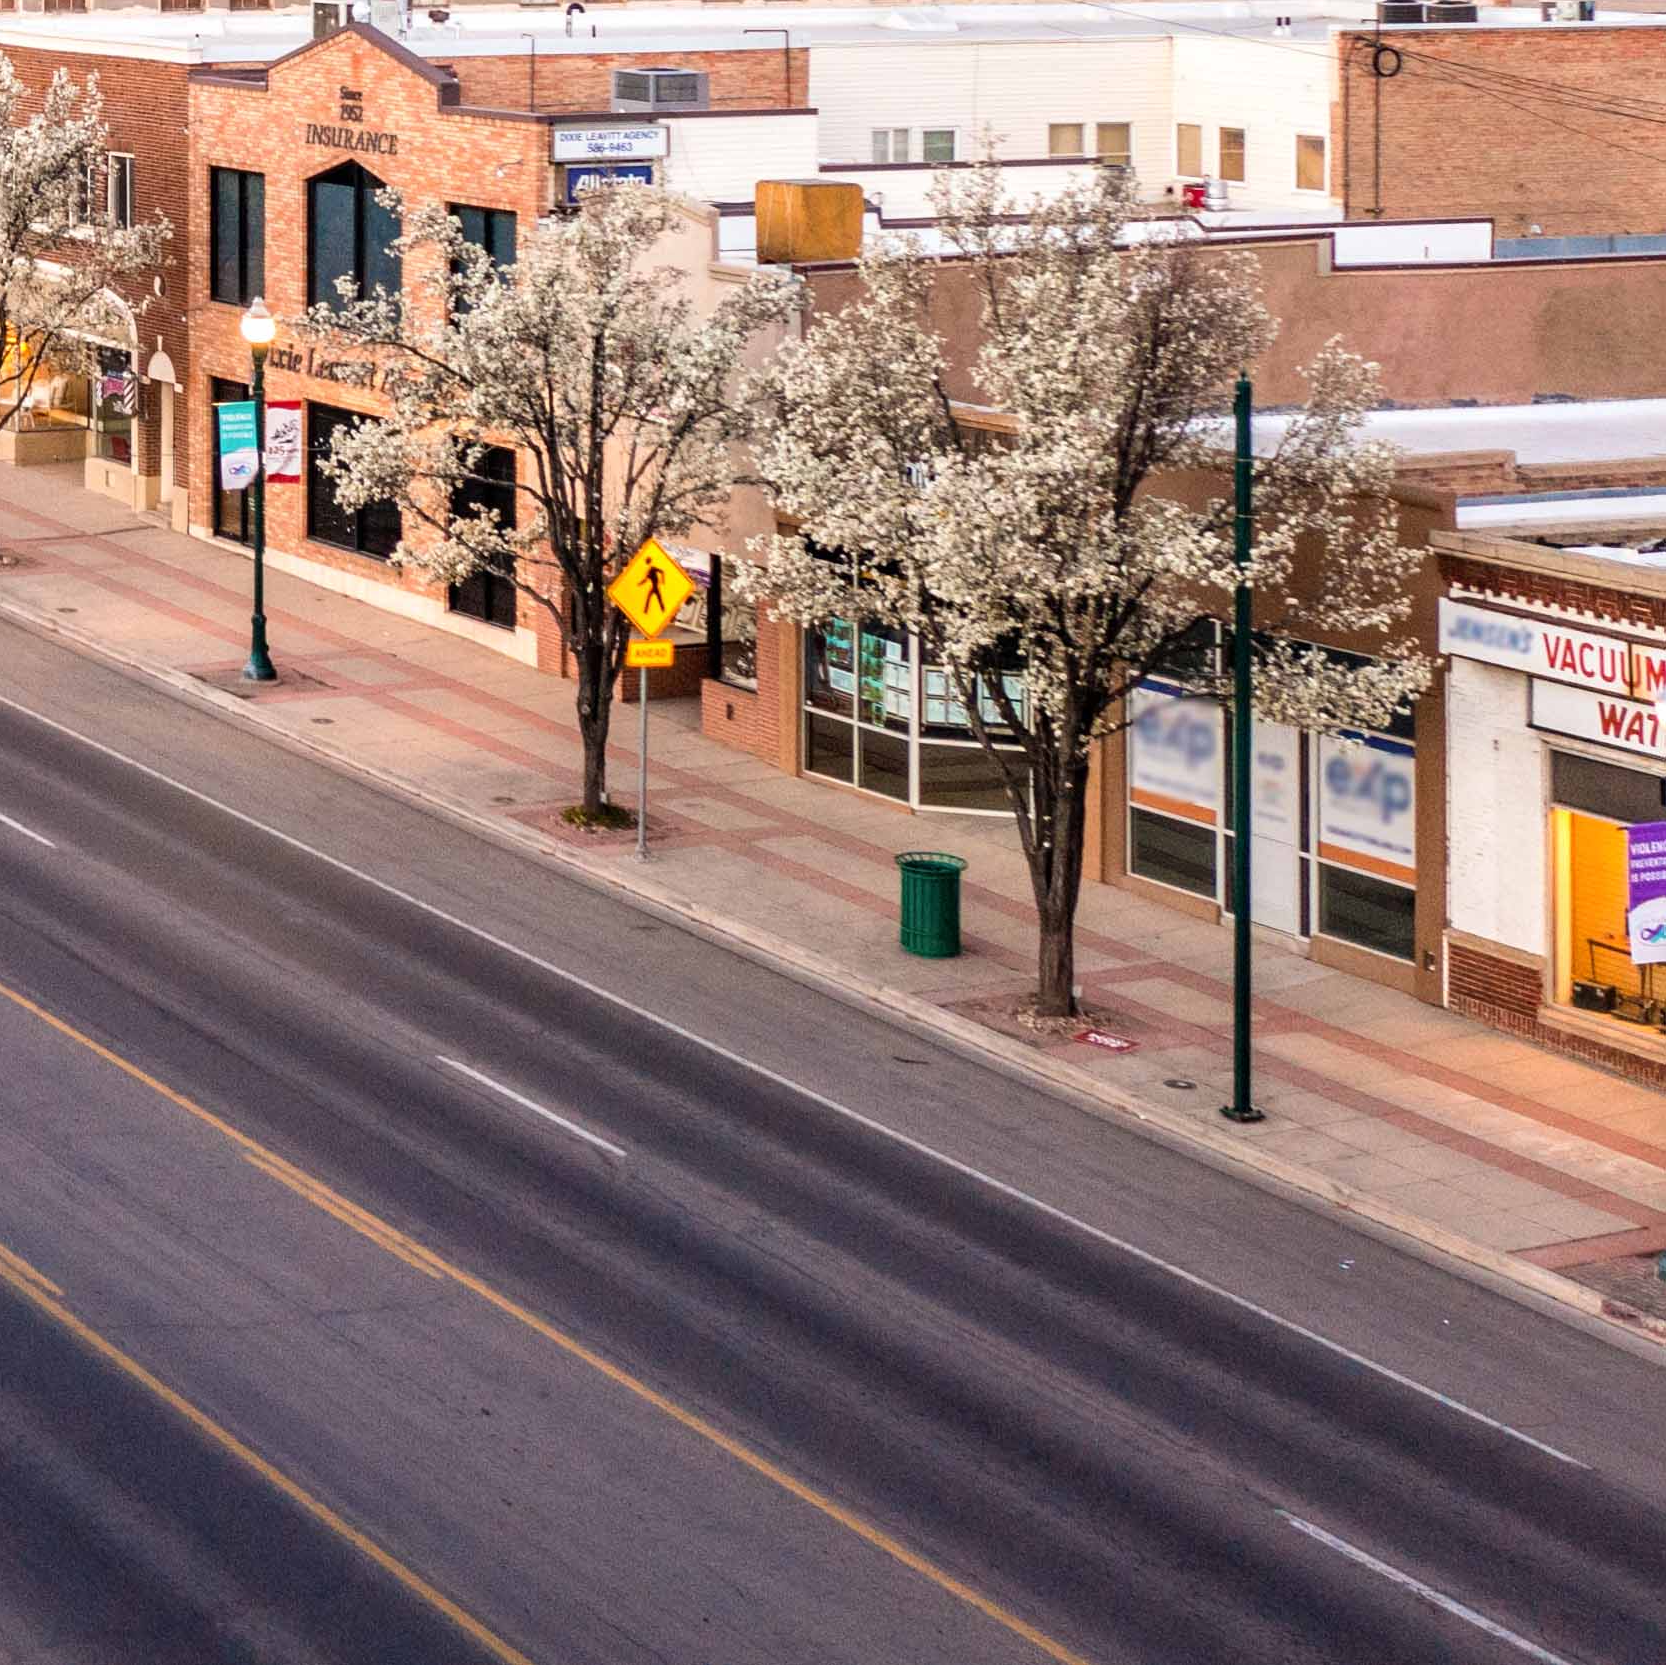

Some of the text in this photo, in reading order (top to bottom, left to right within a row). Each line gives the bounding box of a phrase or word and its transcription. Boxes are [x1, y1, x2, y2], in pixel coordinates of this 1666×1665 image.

[305, 123, 399, 156] INSURANCE
[560, 130, 659, 142] DIXIE LEAVITT AGENCY
[636, 648, 667, 657] AHEAD
